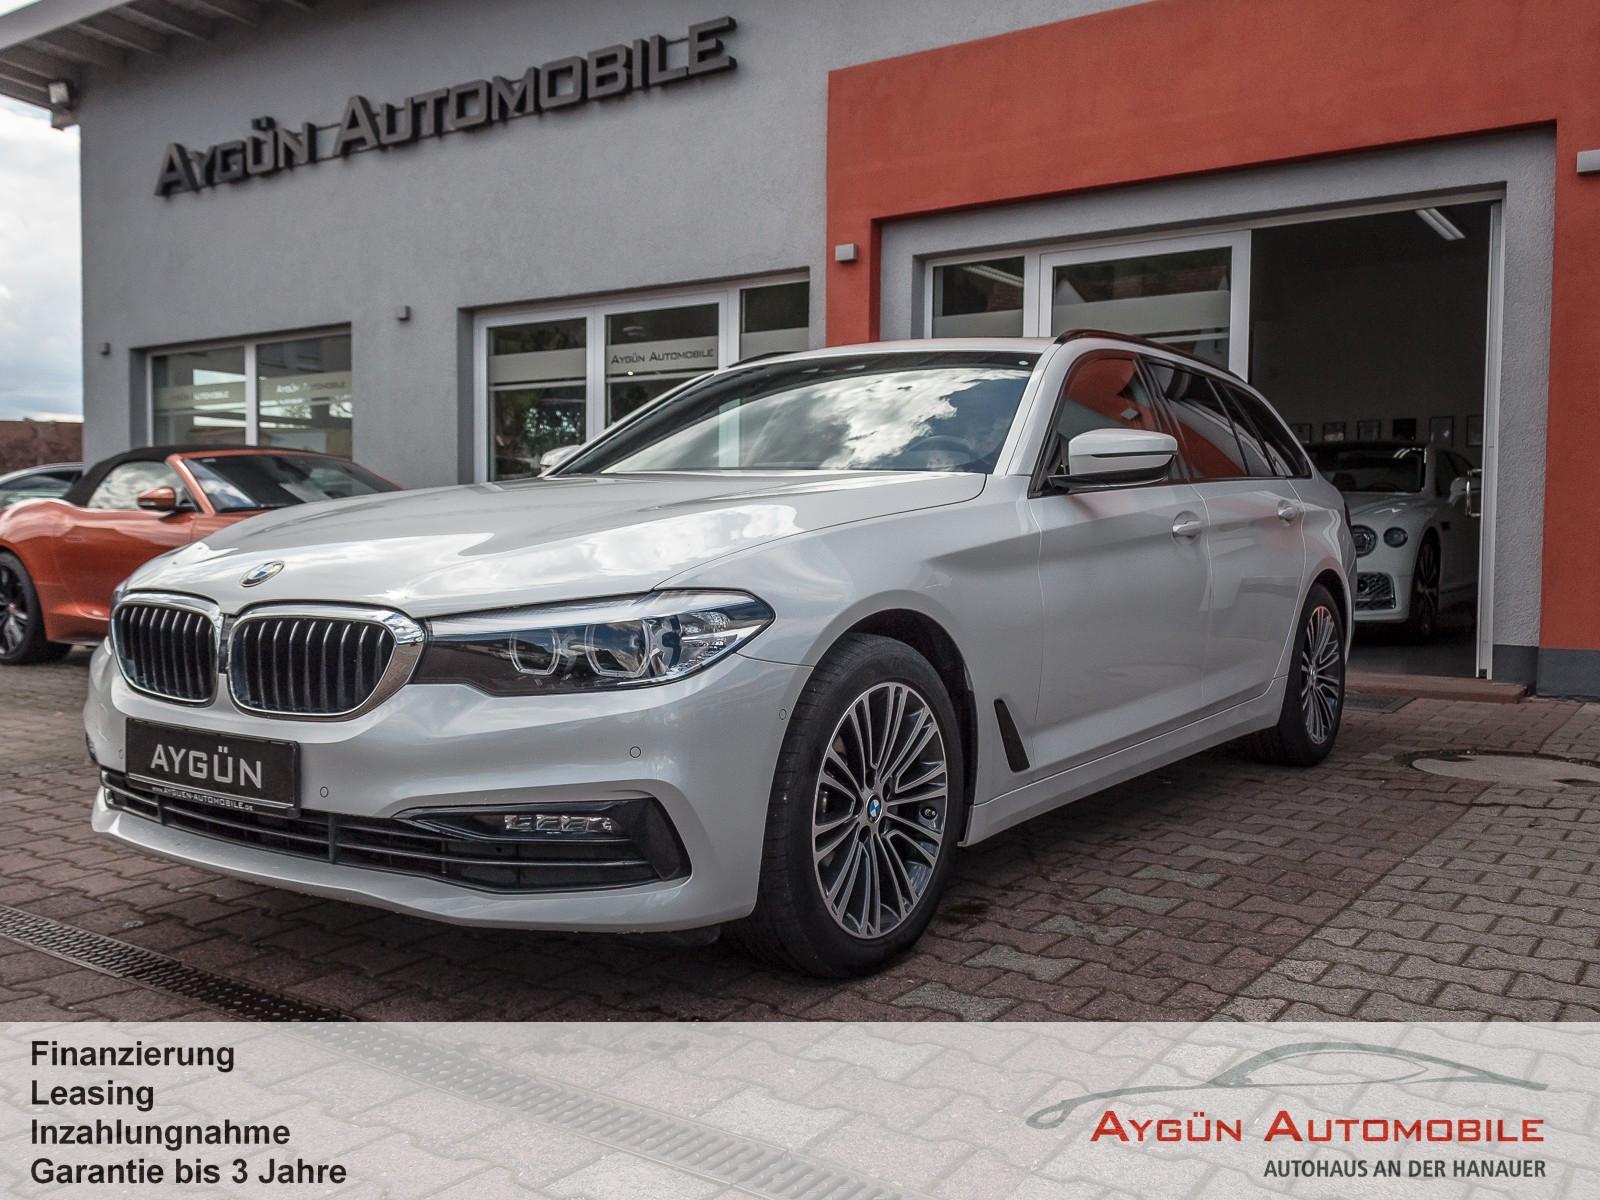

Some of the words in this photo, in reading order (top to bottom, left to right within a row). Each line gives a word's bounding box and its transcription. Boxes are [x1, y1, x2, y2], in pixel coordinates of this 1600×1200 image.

[153, 115, 317, 197] AYGÜN
[332, 15, 738, 158] AUTOMOBILE
[150, 743, 262, 789] AYGÜN
